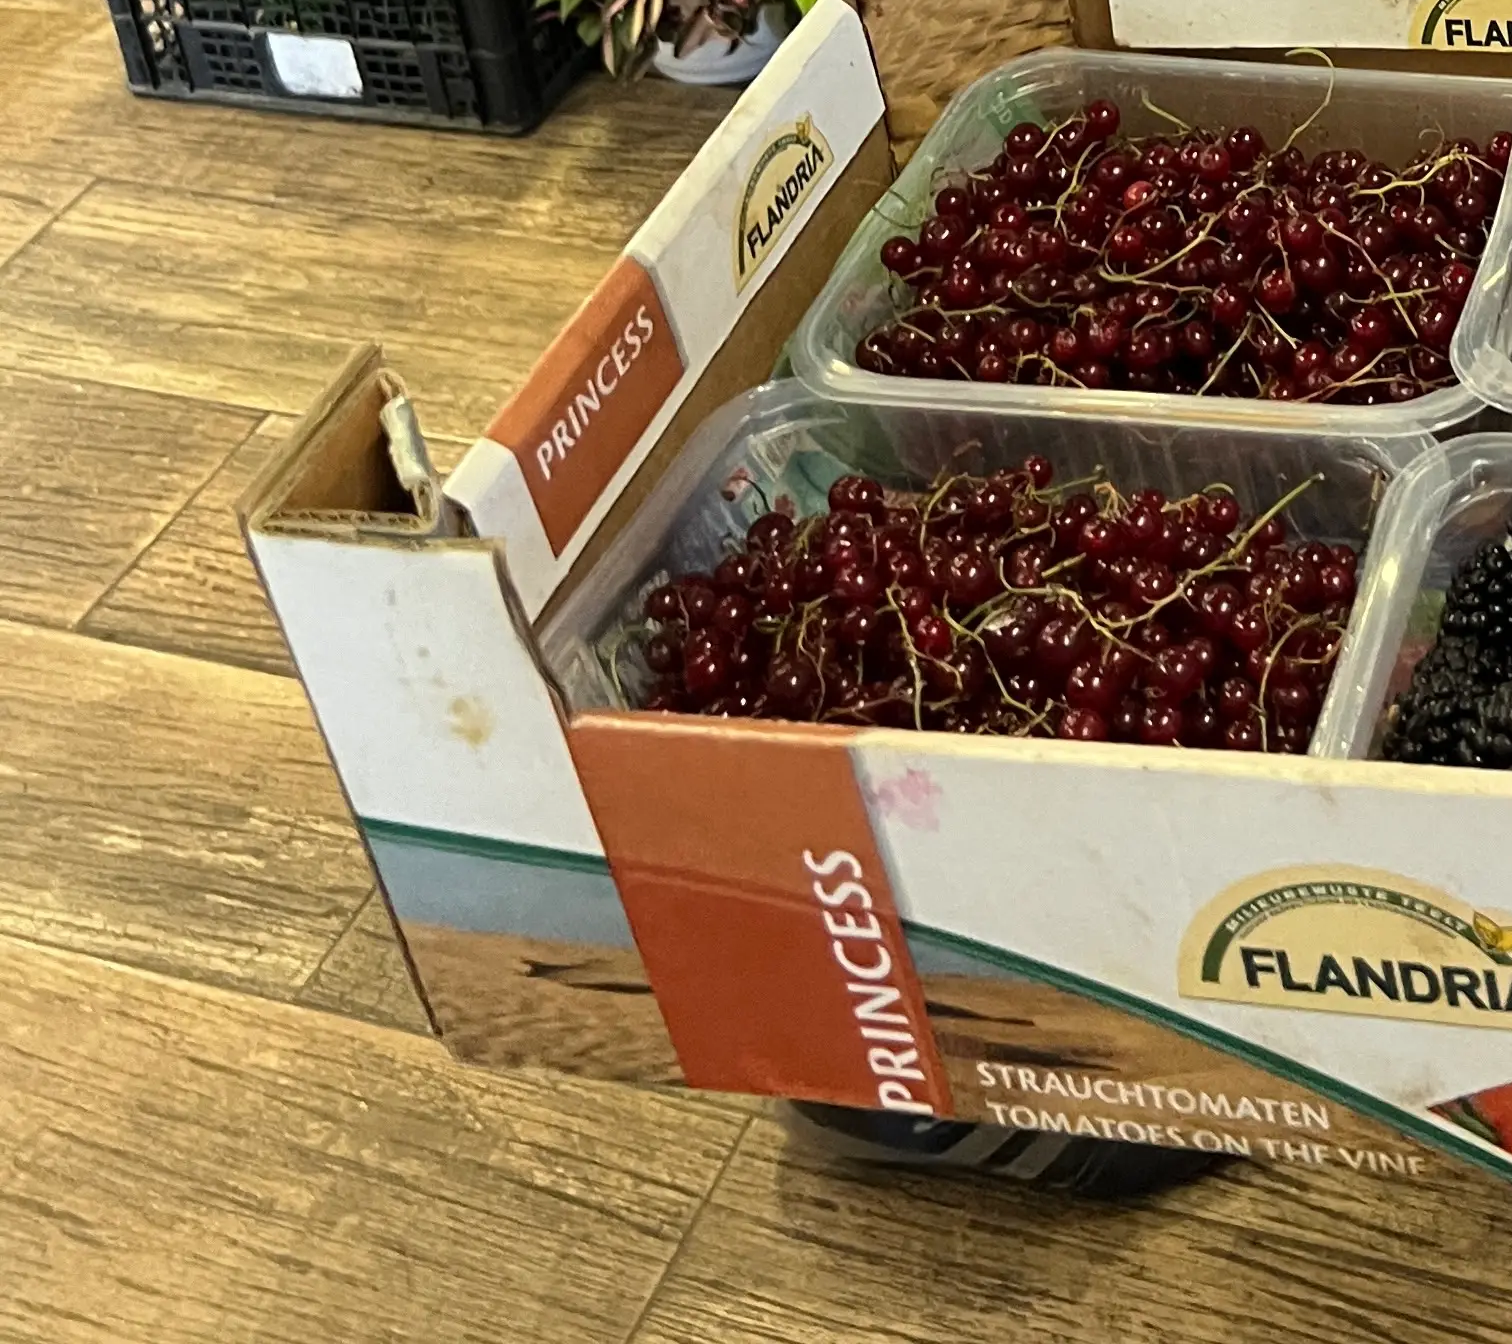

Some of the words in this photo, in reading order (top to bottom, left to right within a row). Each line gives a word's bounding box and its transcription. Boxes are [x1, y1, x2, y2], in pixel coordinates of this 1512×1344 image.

[746, 143, 826, 259] FLANDRIA
[535, 304, 655, 481] PRINCESS
[803, 848, 936, 1116] PRINCESS
[976, 1063, 1331, 1131] STRAUCHTOMATEN
[985, 1100, 1186, 1145] TOMATOES
[1192, 1129, 1251, 1158] ON
[1265, 1138, 1331, 1165] THE
[1340, 1149, 1428, 1178] VINE
